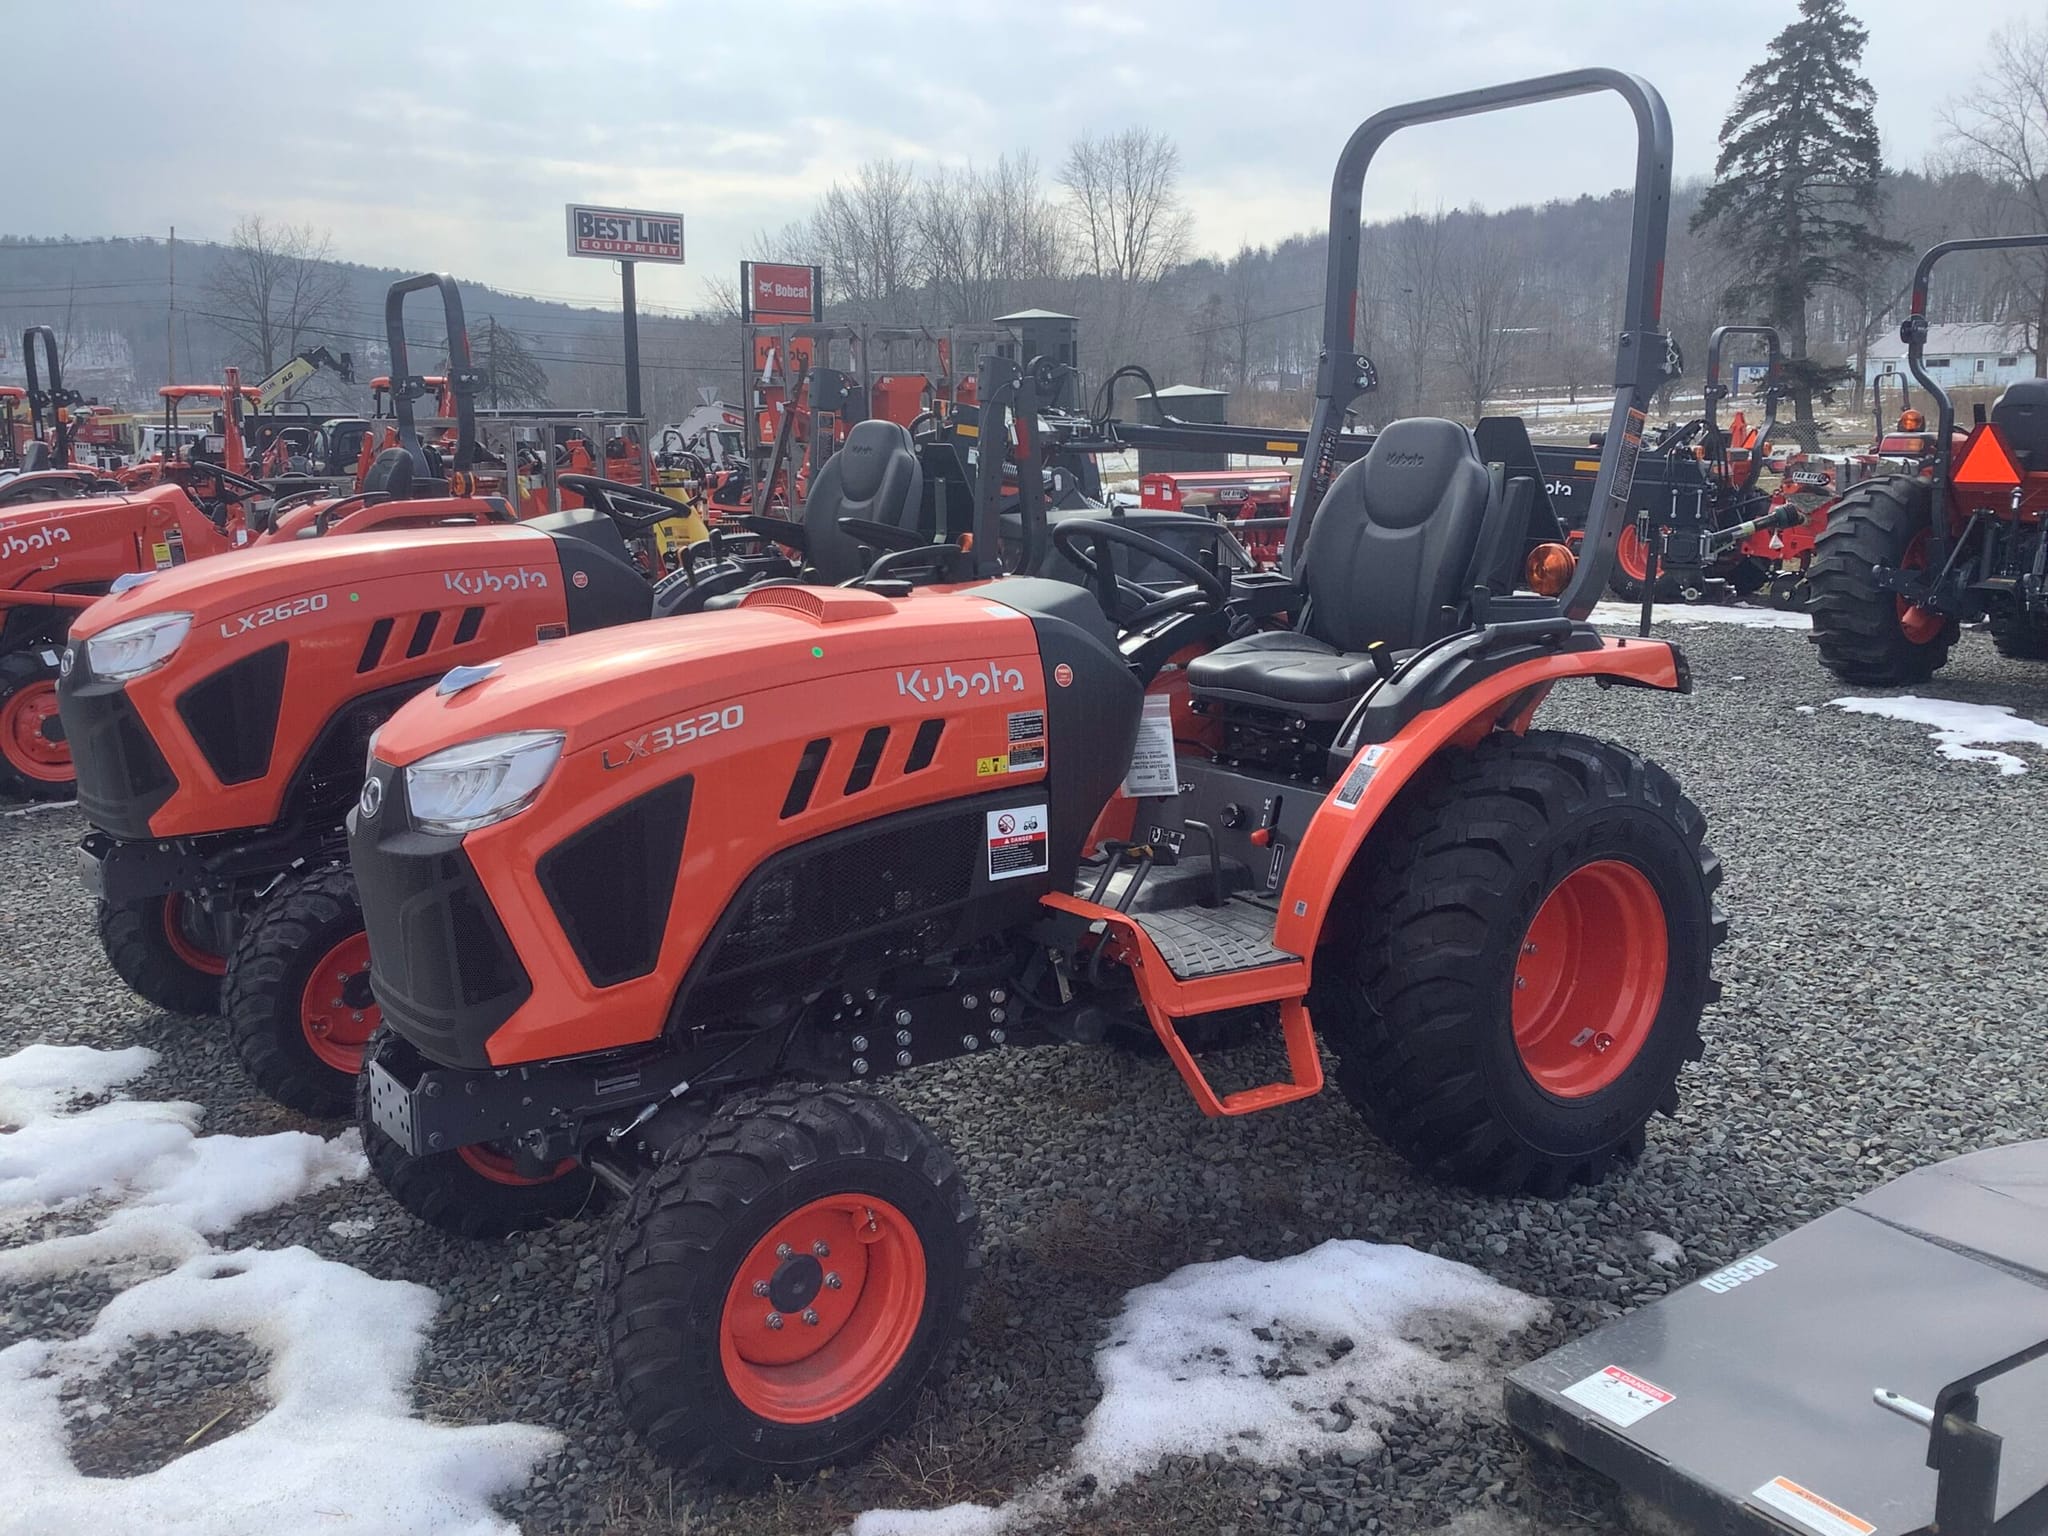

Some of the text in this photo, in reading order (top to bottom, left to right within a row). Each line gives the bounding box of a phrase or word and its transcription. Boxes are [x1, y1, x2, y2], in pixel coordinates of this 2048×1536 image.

[577, 211, 680, 245] BEST LINE
[581, 240, 678, 255] EQUIPMENT
[775, 283, 808, 299] Bobcat
[1545, 480, 1572, 496] ota
[2, 526, 71, 559] ubota
[444, 567, 547, 595] Kubota
[220, 593, 328, 639] LX2620
[896, 661, 1025, 702] Kubota
[602, 704, 744, 771] LX3520
[1621, 1375, 1666, 1399] DANGER
